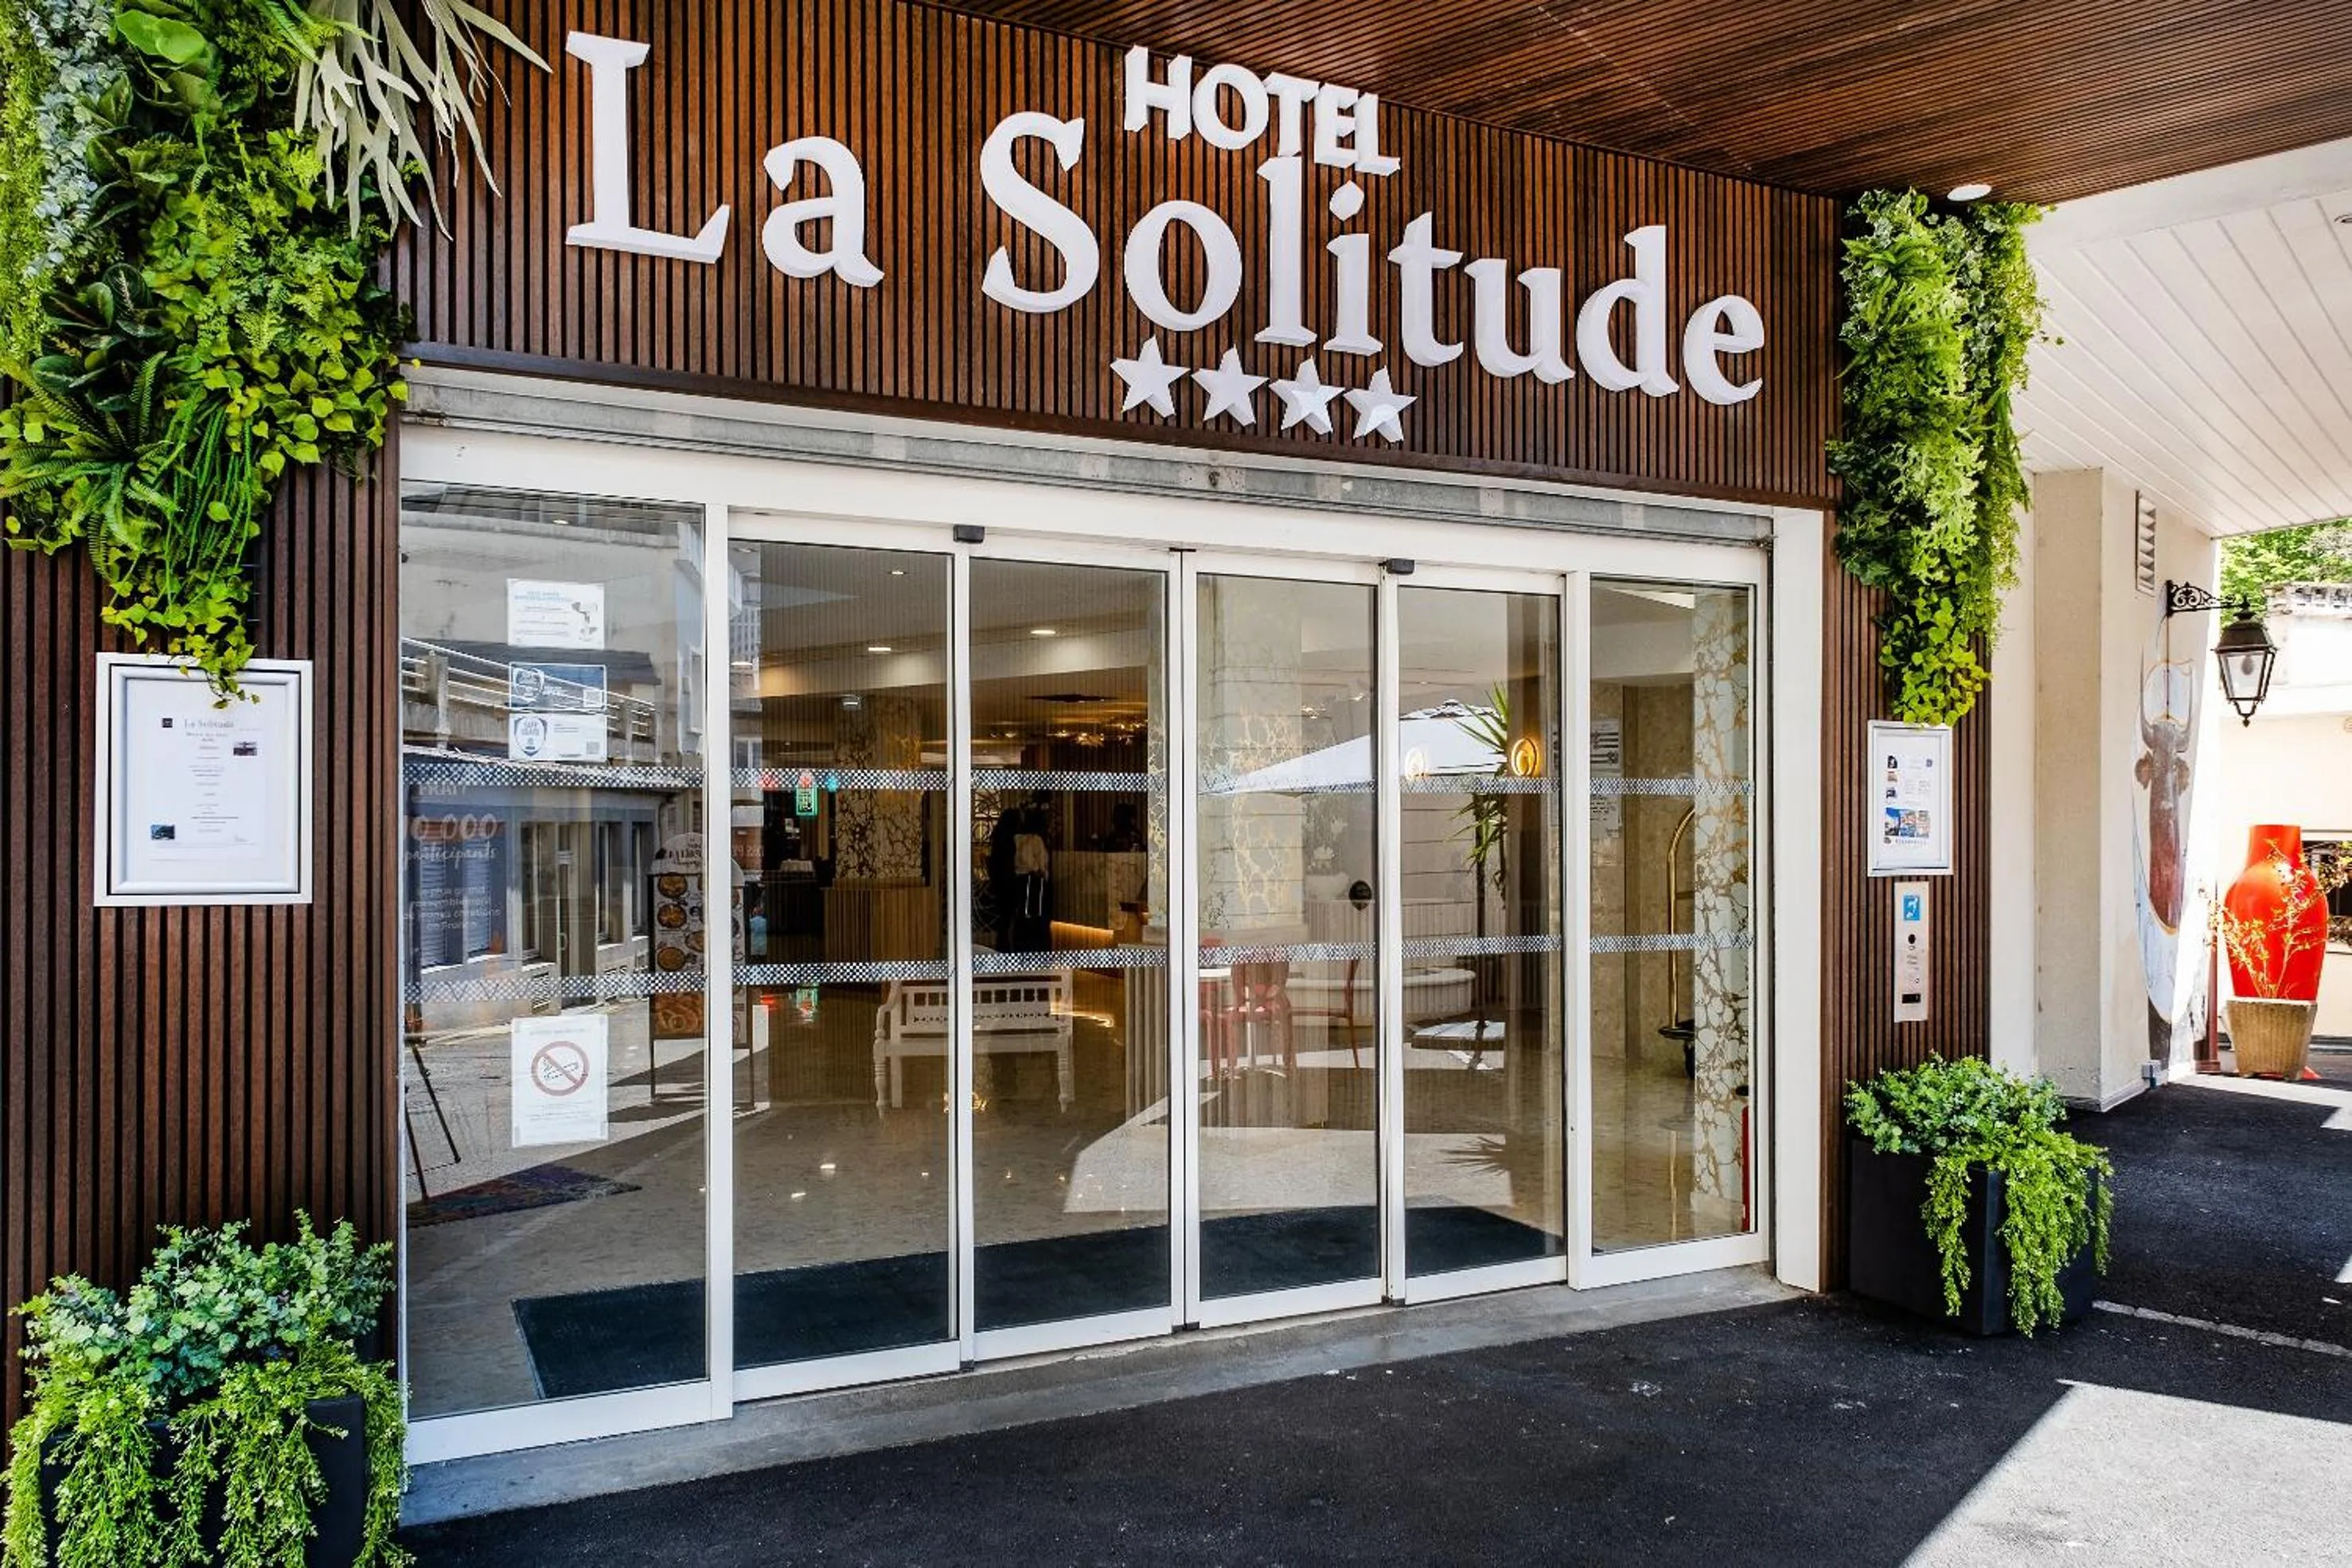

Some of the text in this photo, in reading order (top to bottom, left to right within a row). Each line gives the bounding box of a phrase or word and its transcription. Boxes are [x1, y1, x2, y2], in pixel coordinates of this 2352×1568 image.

[565, 30, 1765, 405] La Solitude
[1125, 45, 1401, 177] HOTEL
